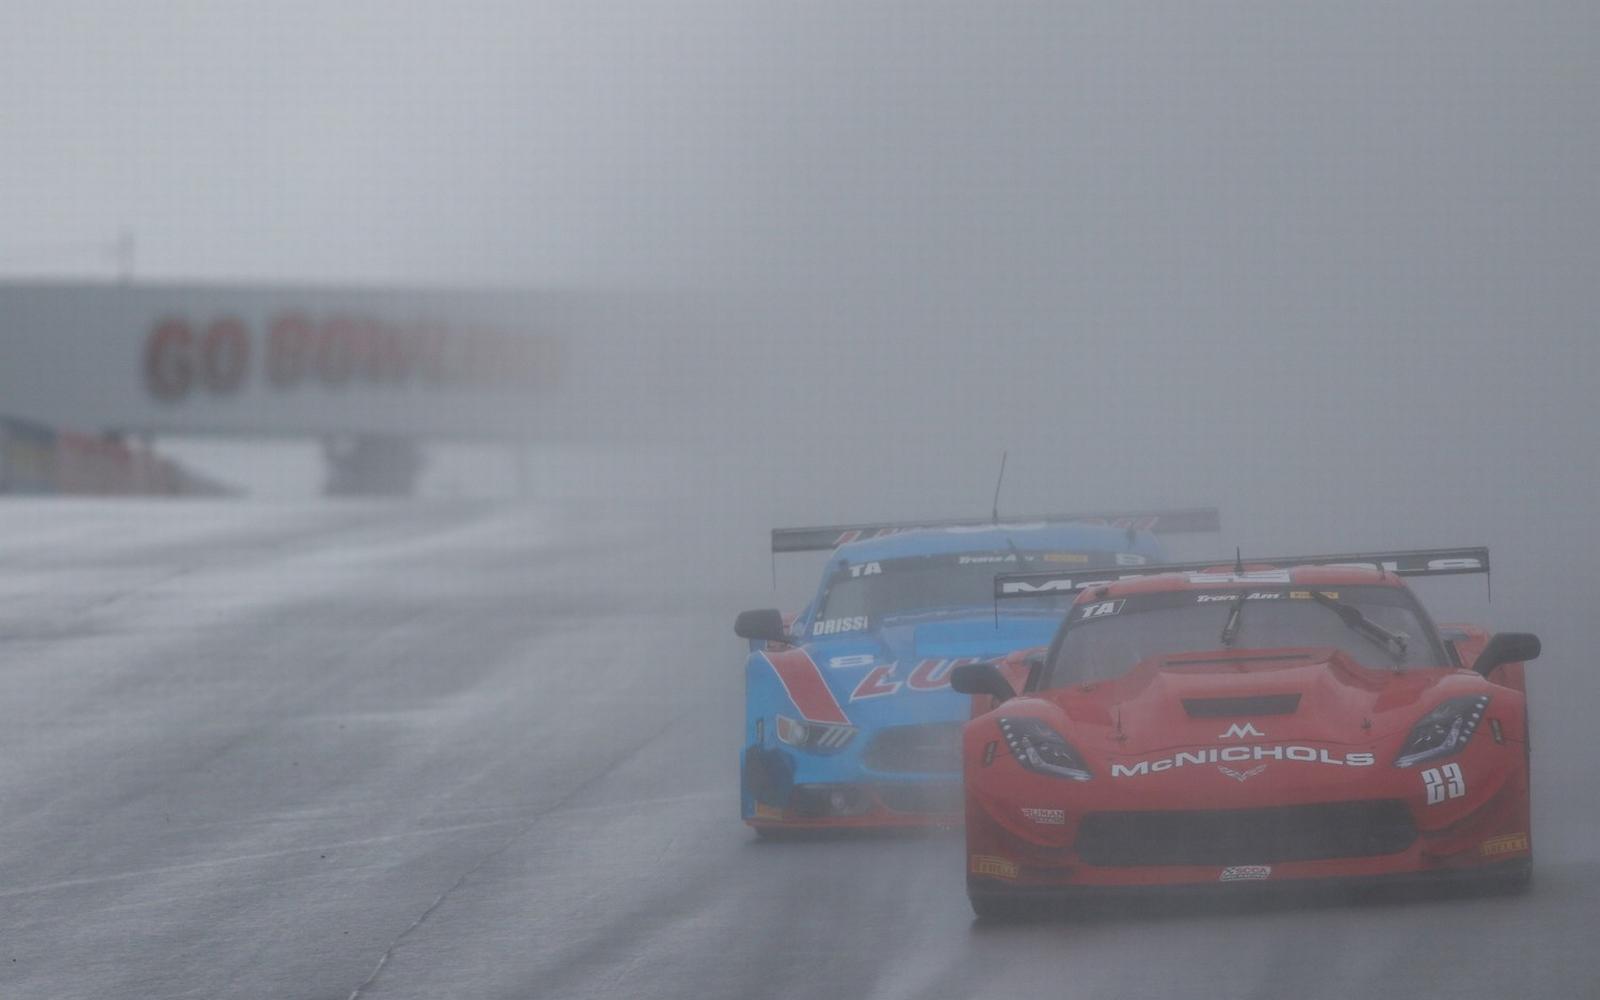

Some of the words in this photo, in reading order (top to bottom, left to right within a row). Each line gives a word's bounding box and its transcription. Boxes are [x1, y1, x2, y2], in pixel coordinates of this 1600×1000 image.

[142, 312, 249, 404] GO
[848, 561, 882, 578] TA
[1082, 602, 1115, 618] TA
[812, 615, 869, 636] DRISSI
[1111, 745, 1376, 778] McNICHOLS
[1420, 762, 1466, 806] 23
